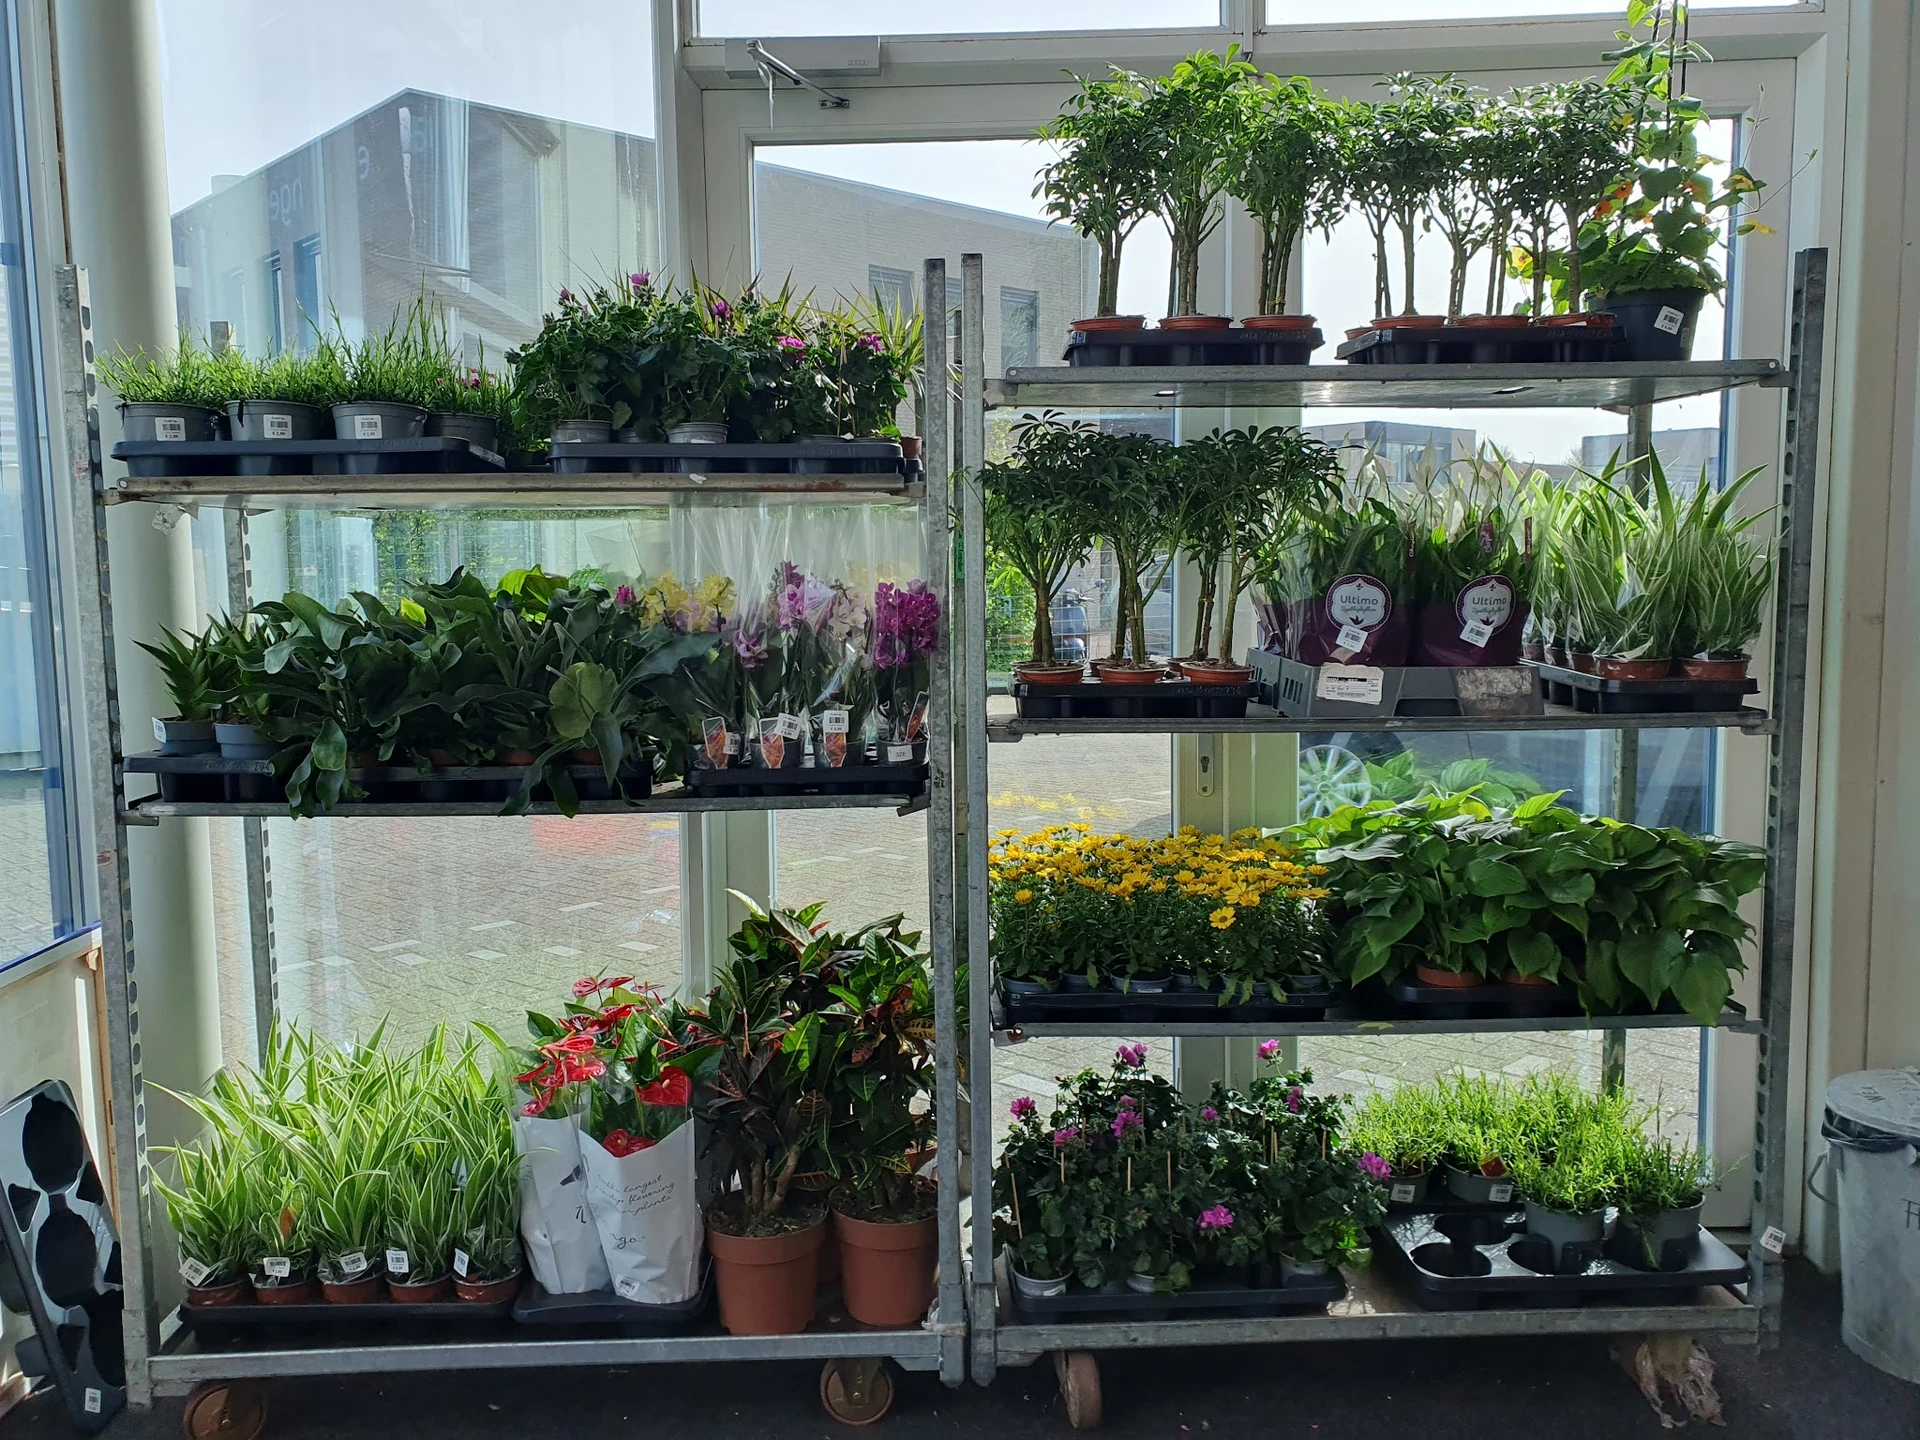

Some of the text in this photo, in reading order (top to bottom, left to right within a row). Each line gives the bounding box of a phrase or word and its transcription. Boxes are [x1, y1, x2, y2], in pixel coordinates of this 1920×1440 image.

[1340, 595, 1379, 606] Ultimo
[1472, 596, 1508, 606] Ultimo
[623, 1174, 663, 1194] longest
[628, 1182, 676, 1206] flowering
